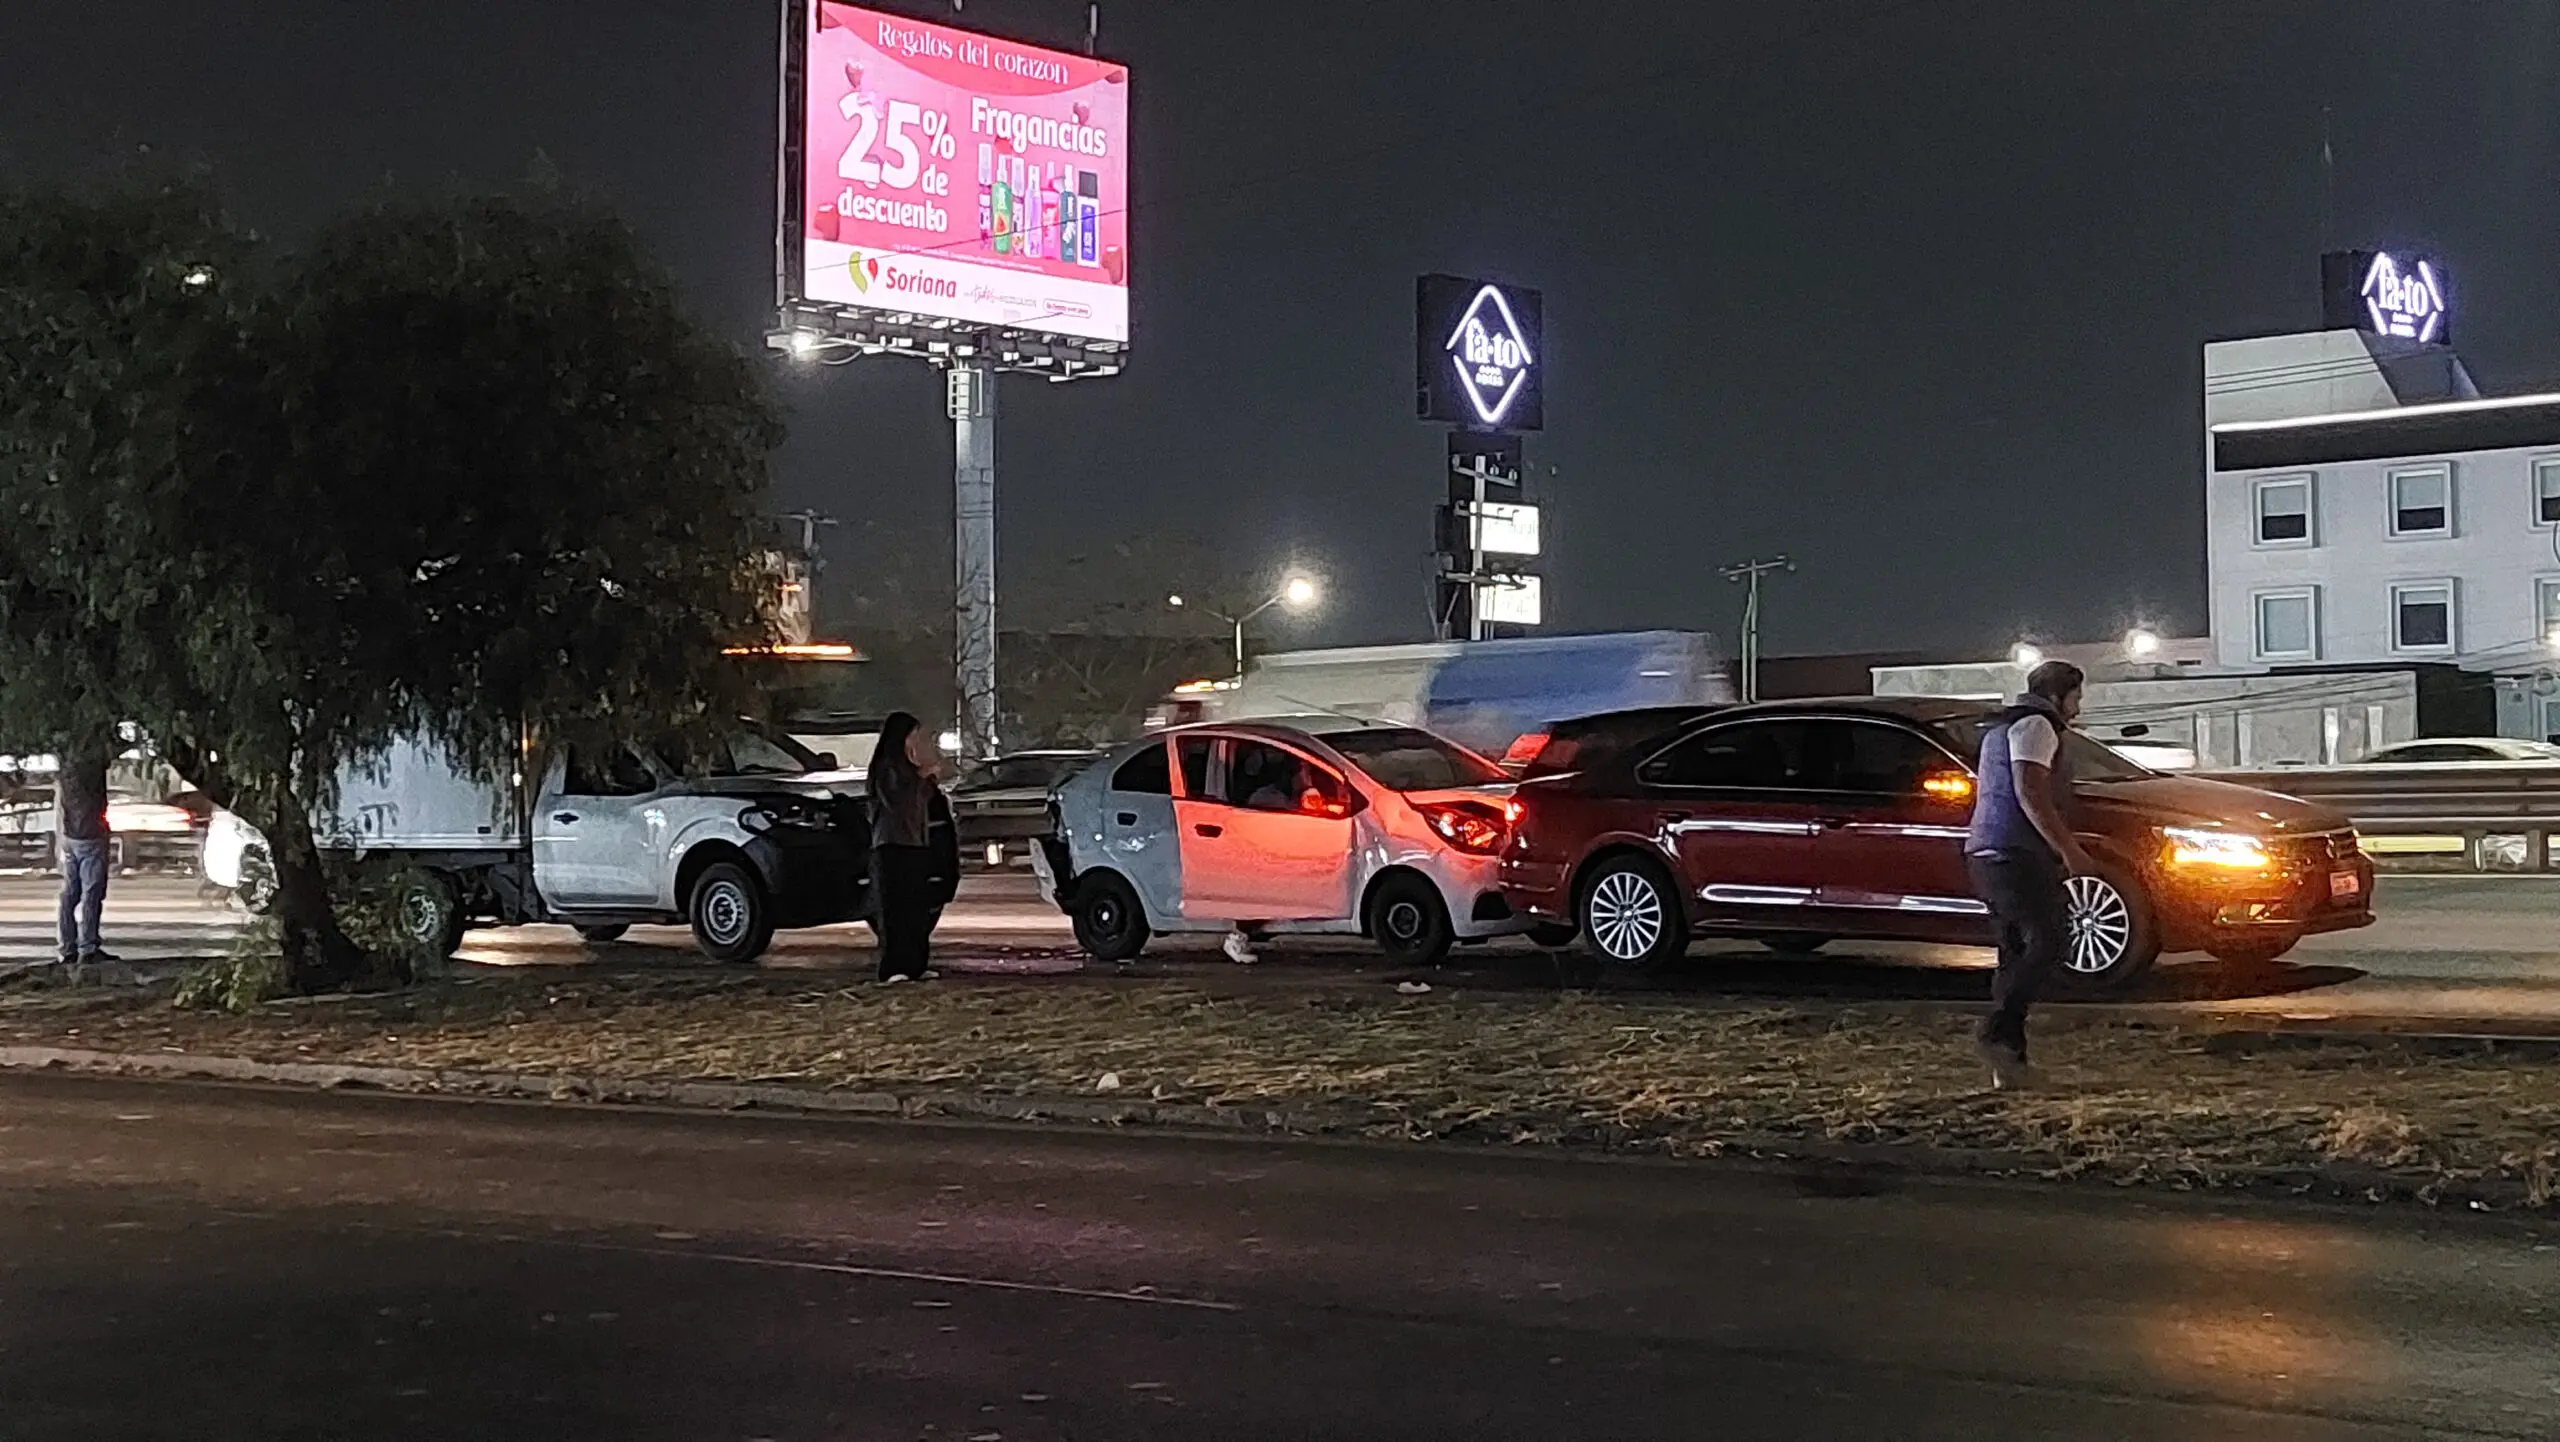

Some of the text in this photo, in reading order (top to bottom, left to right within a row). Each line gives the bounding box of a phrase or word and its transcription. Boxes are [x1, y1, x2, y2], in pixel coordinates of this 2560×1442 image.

[878, 20, 1068, 85] Regalos del corazón
[971, 96, 1107, 157] Fragancias
[921, 162, 949, 196] de
[837, 185, 948, 232] descuento
[886, 266, 957, 298] Soriana
